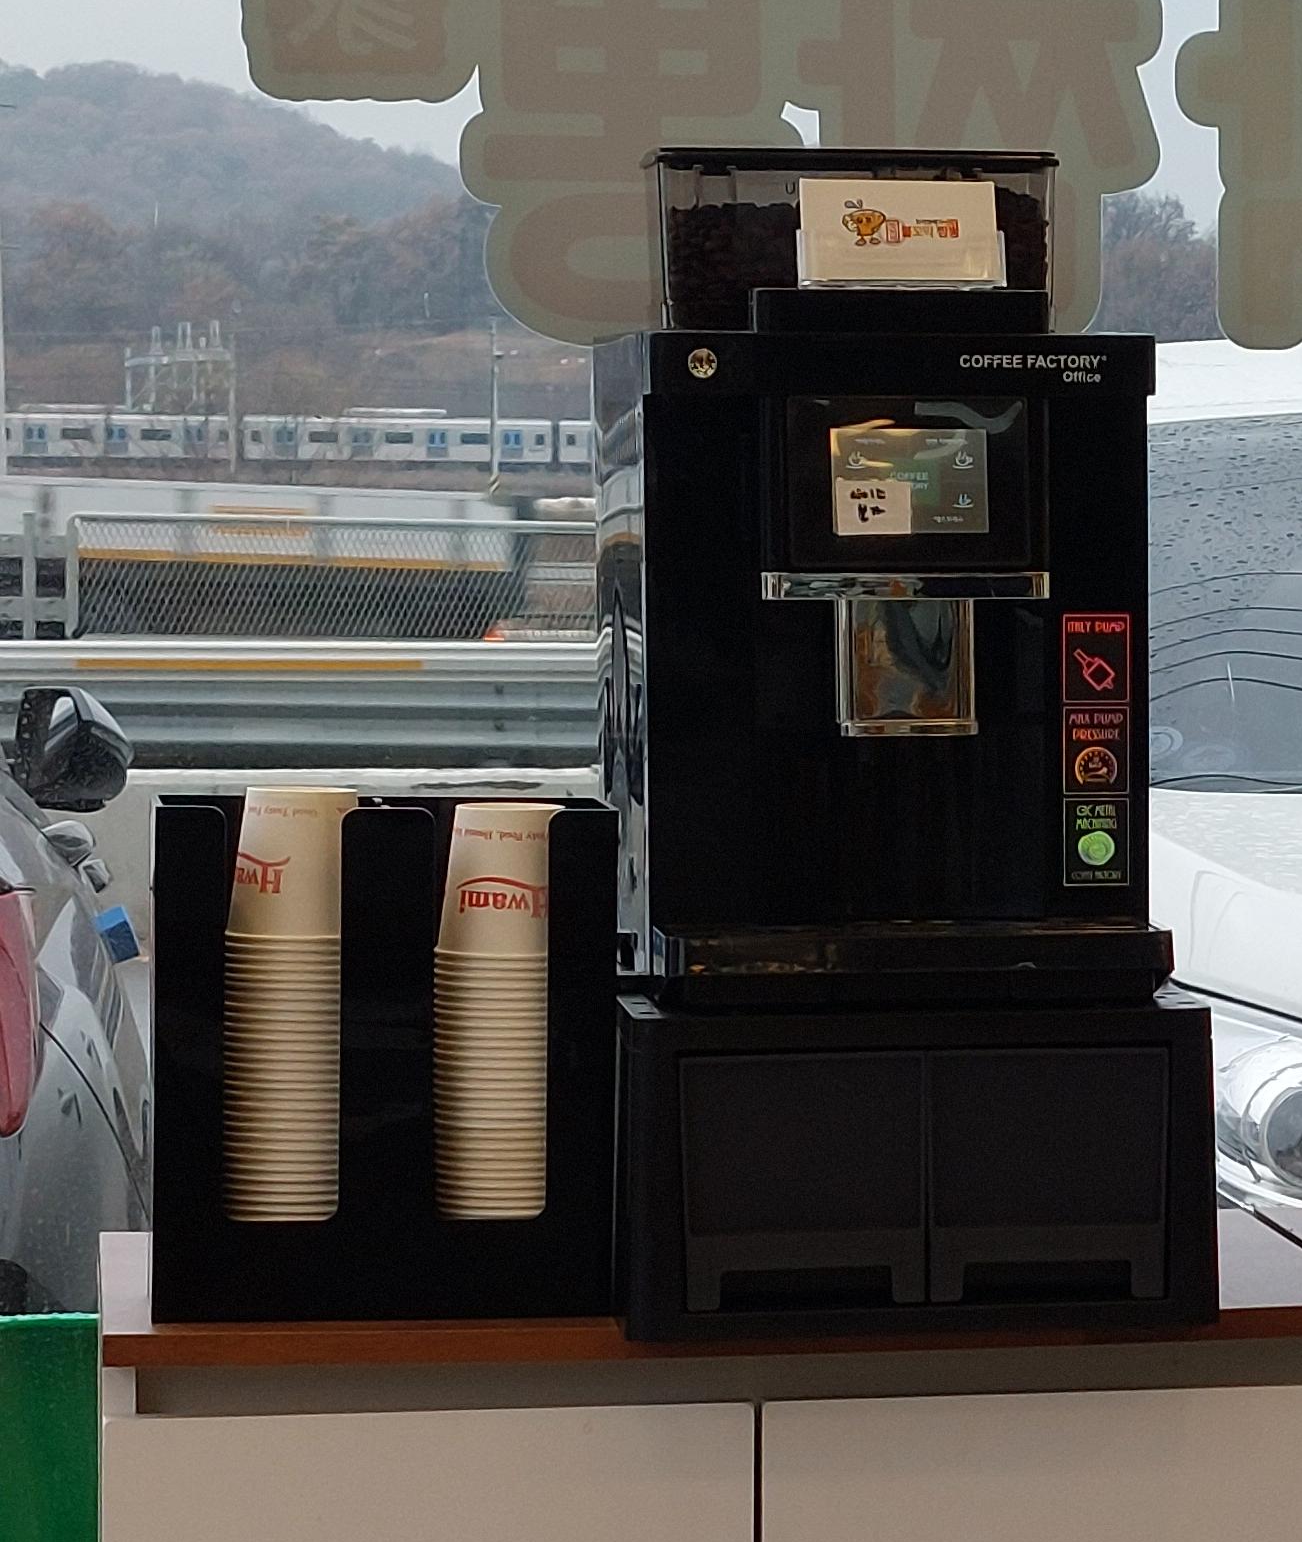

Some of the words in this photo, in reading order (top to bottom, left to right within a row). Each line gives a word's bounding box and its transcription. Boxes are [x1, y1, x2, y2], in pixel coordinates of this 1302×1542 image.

[959, 354, 1023, 368] COFFEE
[1027, 354, 1100, 369] FACTORY
[1062, 370, 1101, 383] Office
